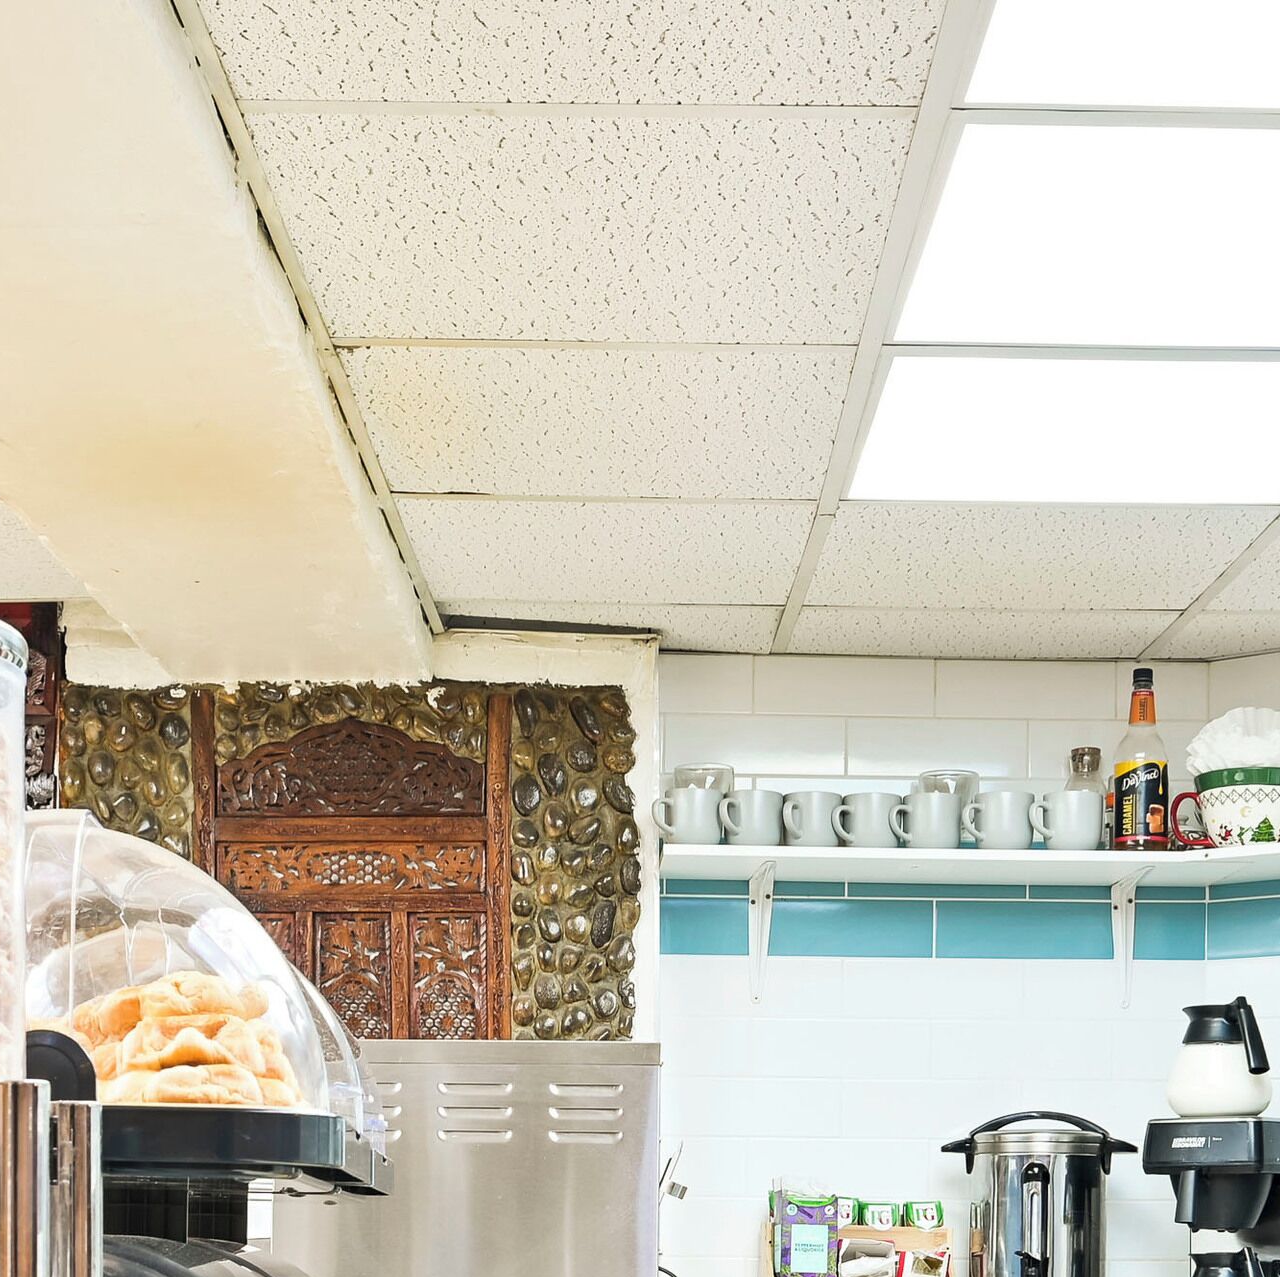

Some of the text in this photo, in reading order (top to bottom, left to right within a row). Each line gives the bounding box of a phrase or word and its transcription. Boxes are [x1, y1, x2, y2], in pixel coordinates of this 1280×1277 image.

[1122, 794, 1133, 836] CARAMEL
[871, 1208, 890, 1225] PG
[915, 1207, 935, 1222] PG
